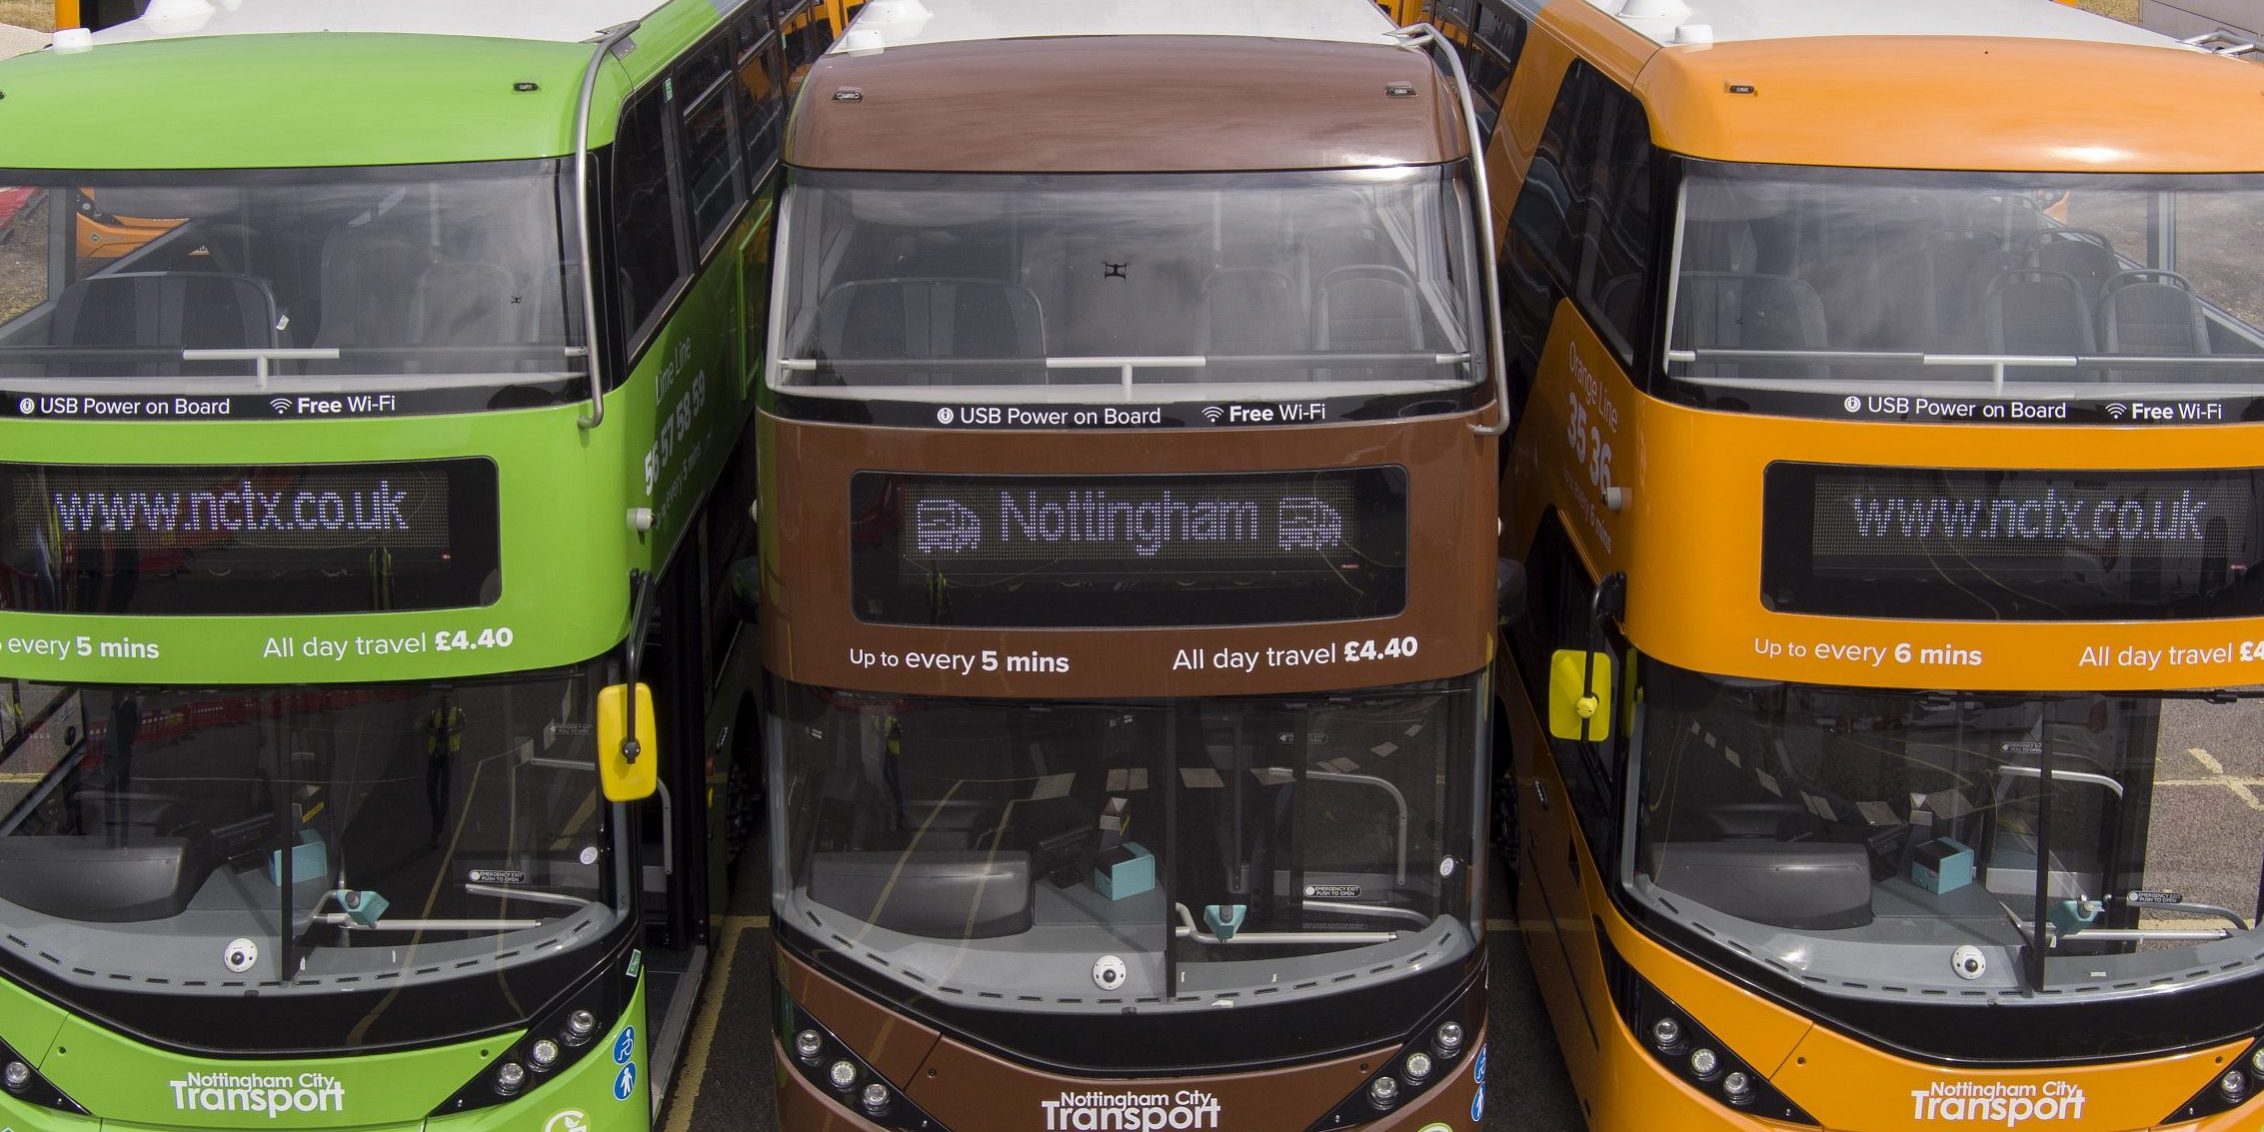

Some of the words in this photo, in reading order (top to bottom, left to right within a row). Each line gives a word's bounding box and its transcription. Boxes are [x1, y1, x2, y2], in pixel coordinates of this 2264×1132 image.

[656, 361, 674, 406] Lime
[675, 336, 691, 374] Line
[1568, 341, 1597, 405] Orange
[1599, 381, 1618, 433] Line
[40, 397, 78, 414] USB
[84, 399, 141, 415] Power
[146, 402, 169, 415] on
[175, 398, 230, 415] Board
[298, 397, 342, 414] Free
[348, 395, 396, 413] Wi-Fi
[960, 408, 1001, 424] USB
[1007, 407, 1068, 425] Power
[1074, 411, 1098, 425] on
[1104, 407, 1161, 424] Board
[1229, 406, 1274, 422] Free
[1279, 404, 1326, 421] Wi-Fi
[1868, 397, 1909, 414] USB
[1915, 400, 1976, 417] Power
[1983, 405, 2005, 418] on
[2012, 402, 2066, 419] Board
[2132, 403, 2173, 419] Free
[2178, 402, 2222, 420] Wi-Fi
[644, 440, 659, 496] 56
[661, 413, 674, 467] 57
[676, 391, 692, 441] 58
[692, 369, 706, 416] 59
[1568, 392, 1587, 463] 35
[1589, 426, 1612, 495] 36
[56, 481, 409, 531] www.nctx.co.uk
[1855, 490, 2206, 540] www.nctx.co.uk
[1001, 491, 1258, 556] Nottingham
[7, 637, 71, 660] every
[76, 636, 92, 656] 5
[100, 637, 160, 659] mins
[263, 638, 294, 658] All
[303, 636, 348, 661] day
[355, 632, 426, 656] travel
[435, 627, 514, 652] £4.40
[1172, 649, 1204, 670] All
[1212, 647, 1260, 673] day
[1267, 642, 1336, 667] travel
[1344, 636, 1419, 662] £4.40
[1754, 638, 1782, 658] Up
[1787, 643, 1807, 658] to
[1814, 643, 1888, 667] every
[1894, 643, 1913, 664] 6
[1921, 643, 1983, 666] mins
[2078, 646, 2110, 666] All
[2118, 645, 2162, 671] day
[2169, 642, 2233, 665] travel
[849, 648, 876, 669] Up
[881, 652, 899, 667] to
[905, 652, 976, 675] every
[982, 651, 999, 672] 5
[1007, 651, 1070, 673] mins
[187, 1072, 293, 1092] Nottingham
[299, 1072, 334, 1092] City
[1930, 1081, 2036, 1102] Nottingham
[2042, 1081, 2078, 1098] City
[170, 1080, 345, 1119] Transport
[1061, 1091, 1170, 1112] Nottingham
[1175, 1090, 1213, 1108] City
[1911, 1089, 2086, 1128] Transport
[1042, 1098, 1221, 1132] Transport
